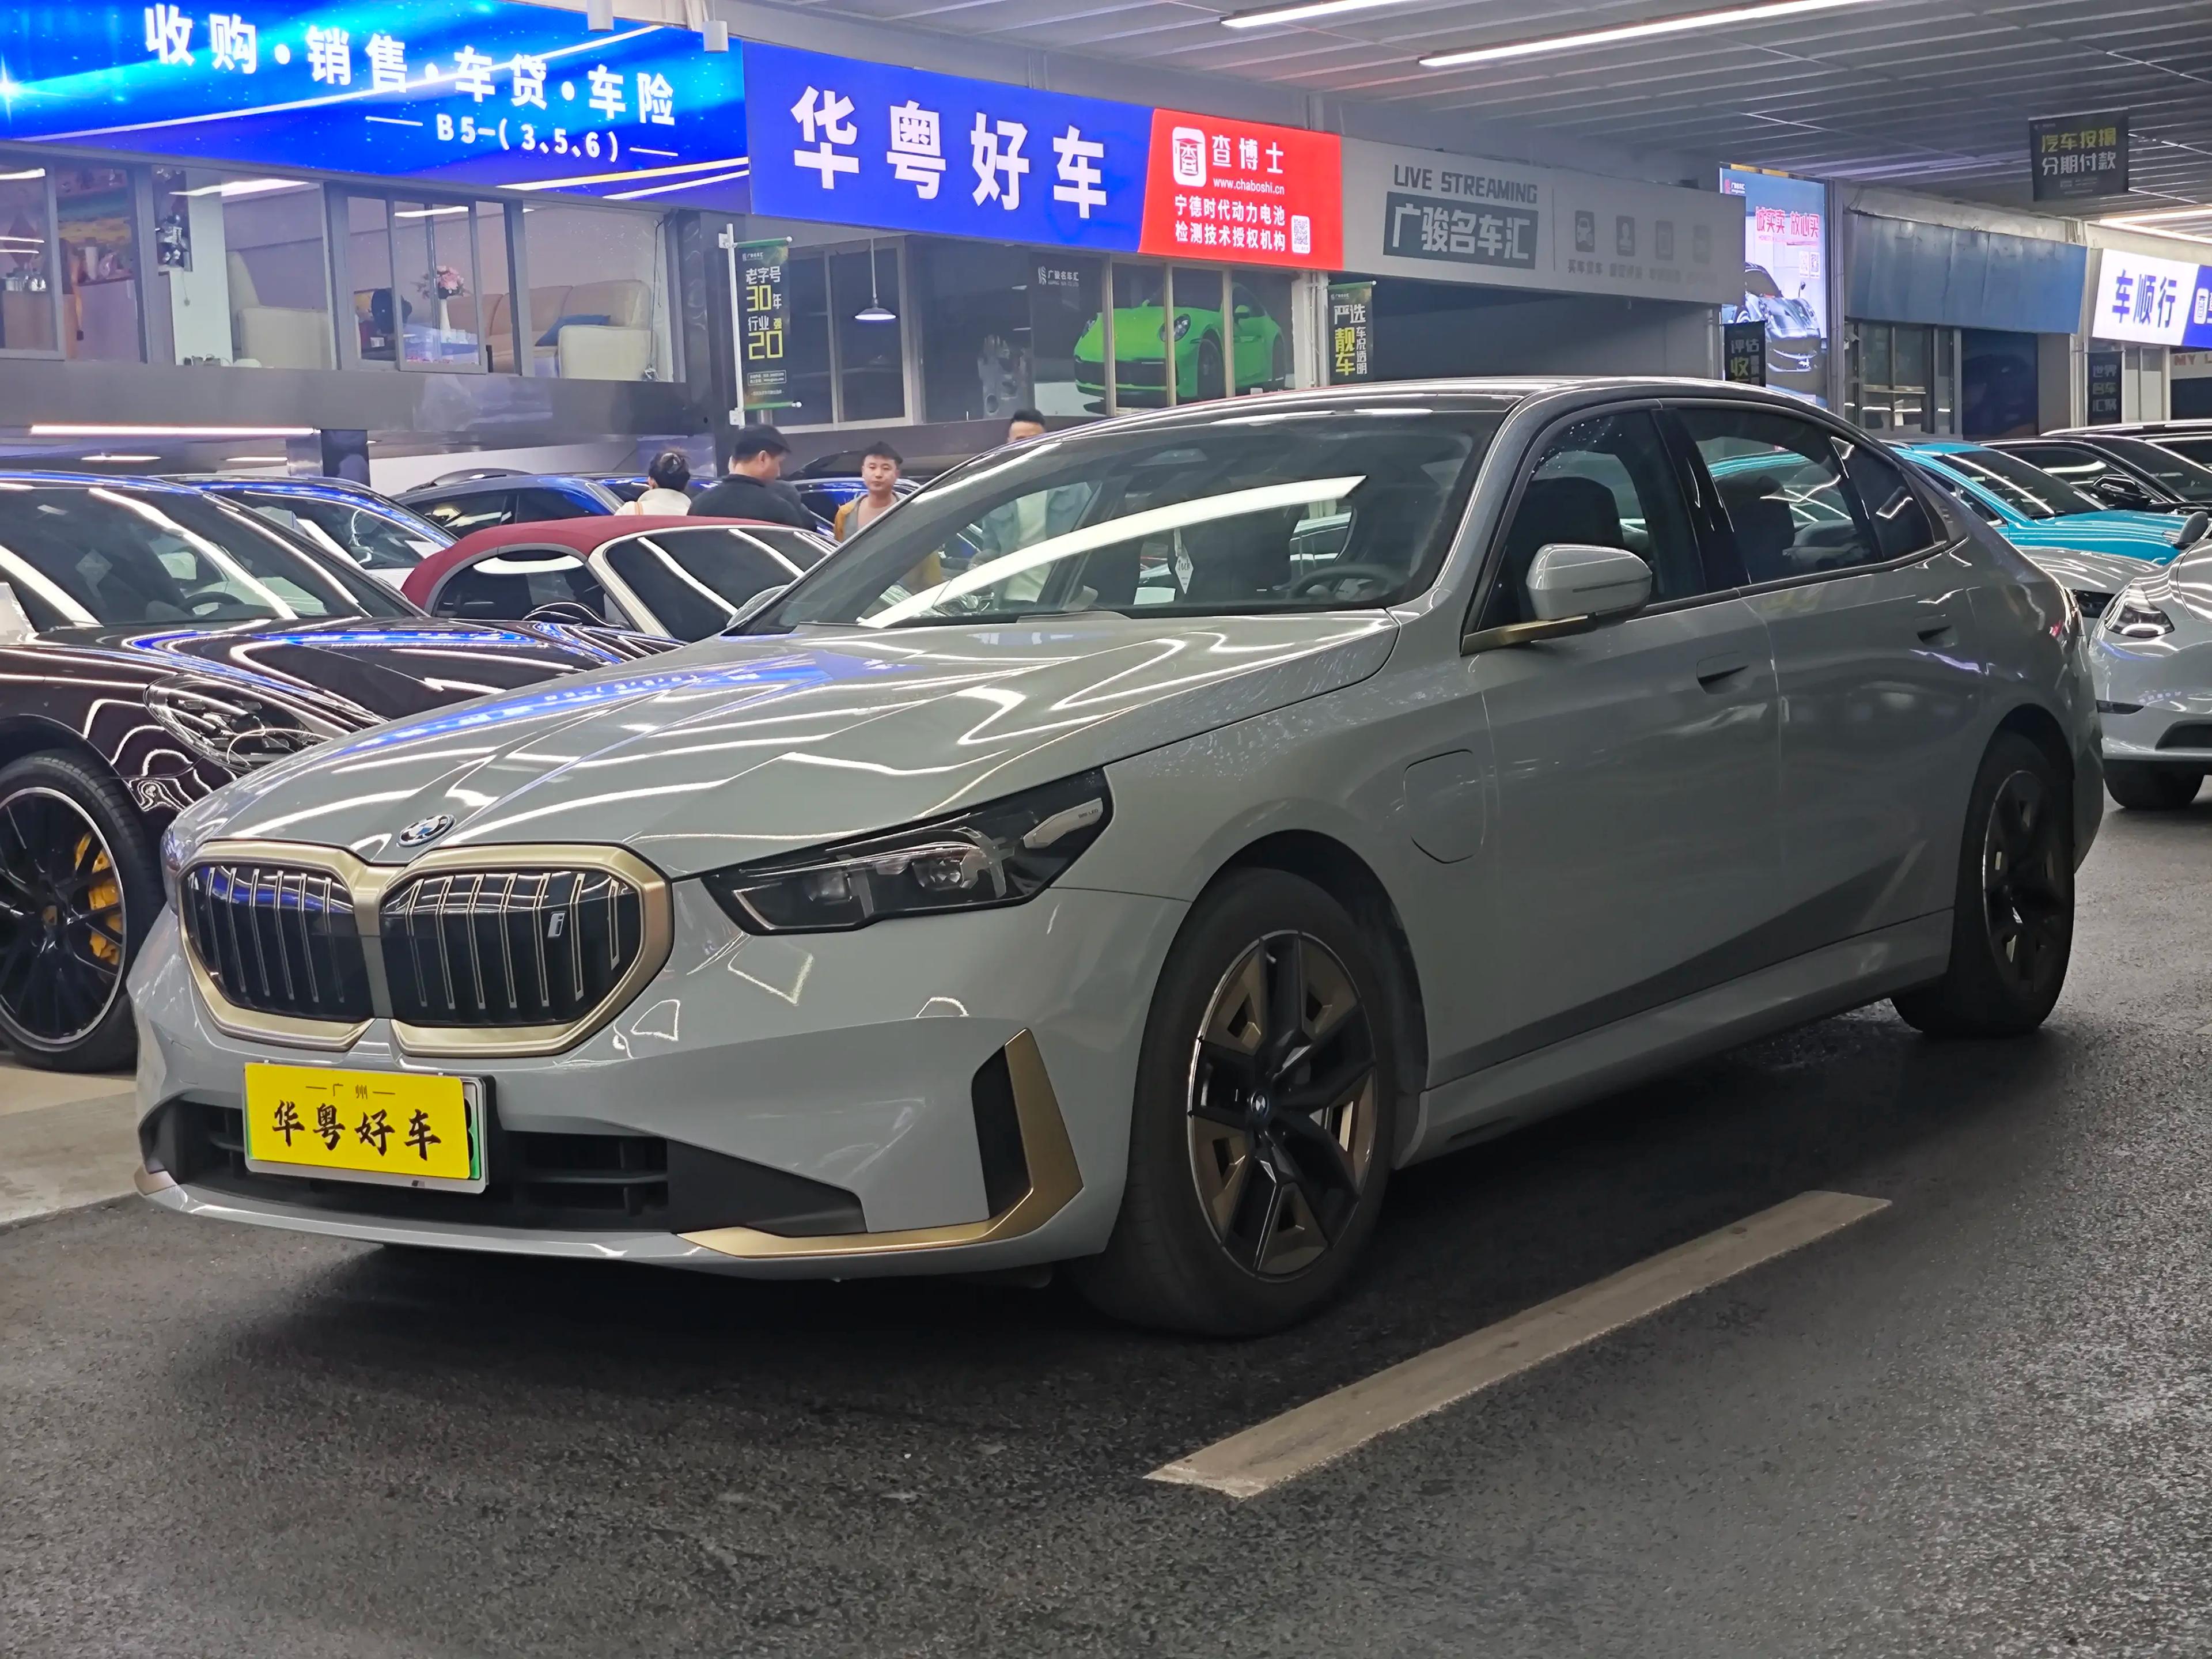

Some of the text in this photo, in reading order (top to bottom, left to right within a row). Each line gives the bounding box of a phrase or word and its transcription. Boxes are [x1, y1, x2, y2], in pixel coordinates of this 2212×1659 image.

[791, 86, 1107, 219] 华粤好车
[1211, 135, 1284, 173] 查博士
[2041, 151, 2116, 176] 分期付款
[1213, 177, 1285, 195] www.chaboshi.cn
[1394, 164, 1537, 204] LIVE STREAMING
[1175, 194, 1285, 226] 宁德时代动力电池
[1790, 211, 1819, 237] 放心买
[1175, 221, 1286, 252] 检测技术授权机构
[1392, 203, 1531, 260] 广骏名车汇
[746, 266, 781, 285] 老字号
[2112, 268, 2177, 328] 车顺行
[1334, 304, 1366, 324] 严选
[749, 331, 783, 359] 20
[1335, 327, 1355, 376] 靓车
[1356, 327, 1368, 374] 车况透明
[1730, 338, 1759, 354] 评估
[2175, 354, 2196, 365] MY
[333, 1083, 368, 1099] 广州
[272, 1100, 442, 1161] 华粤好车
